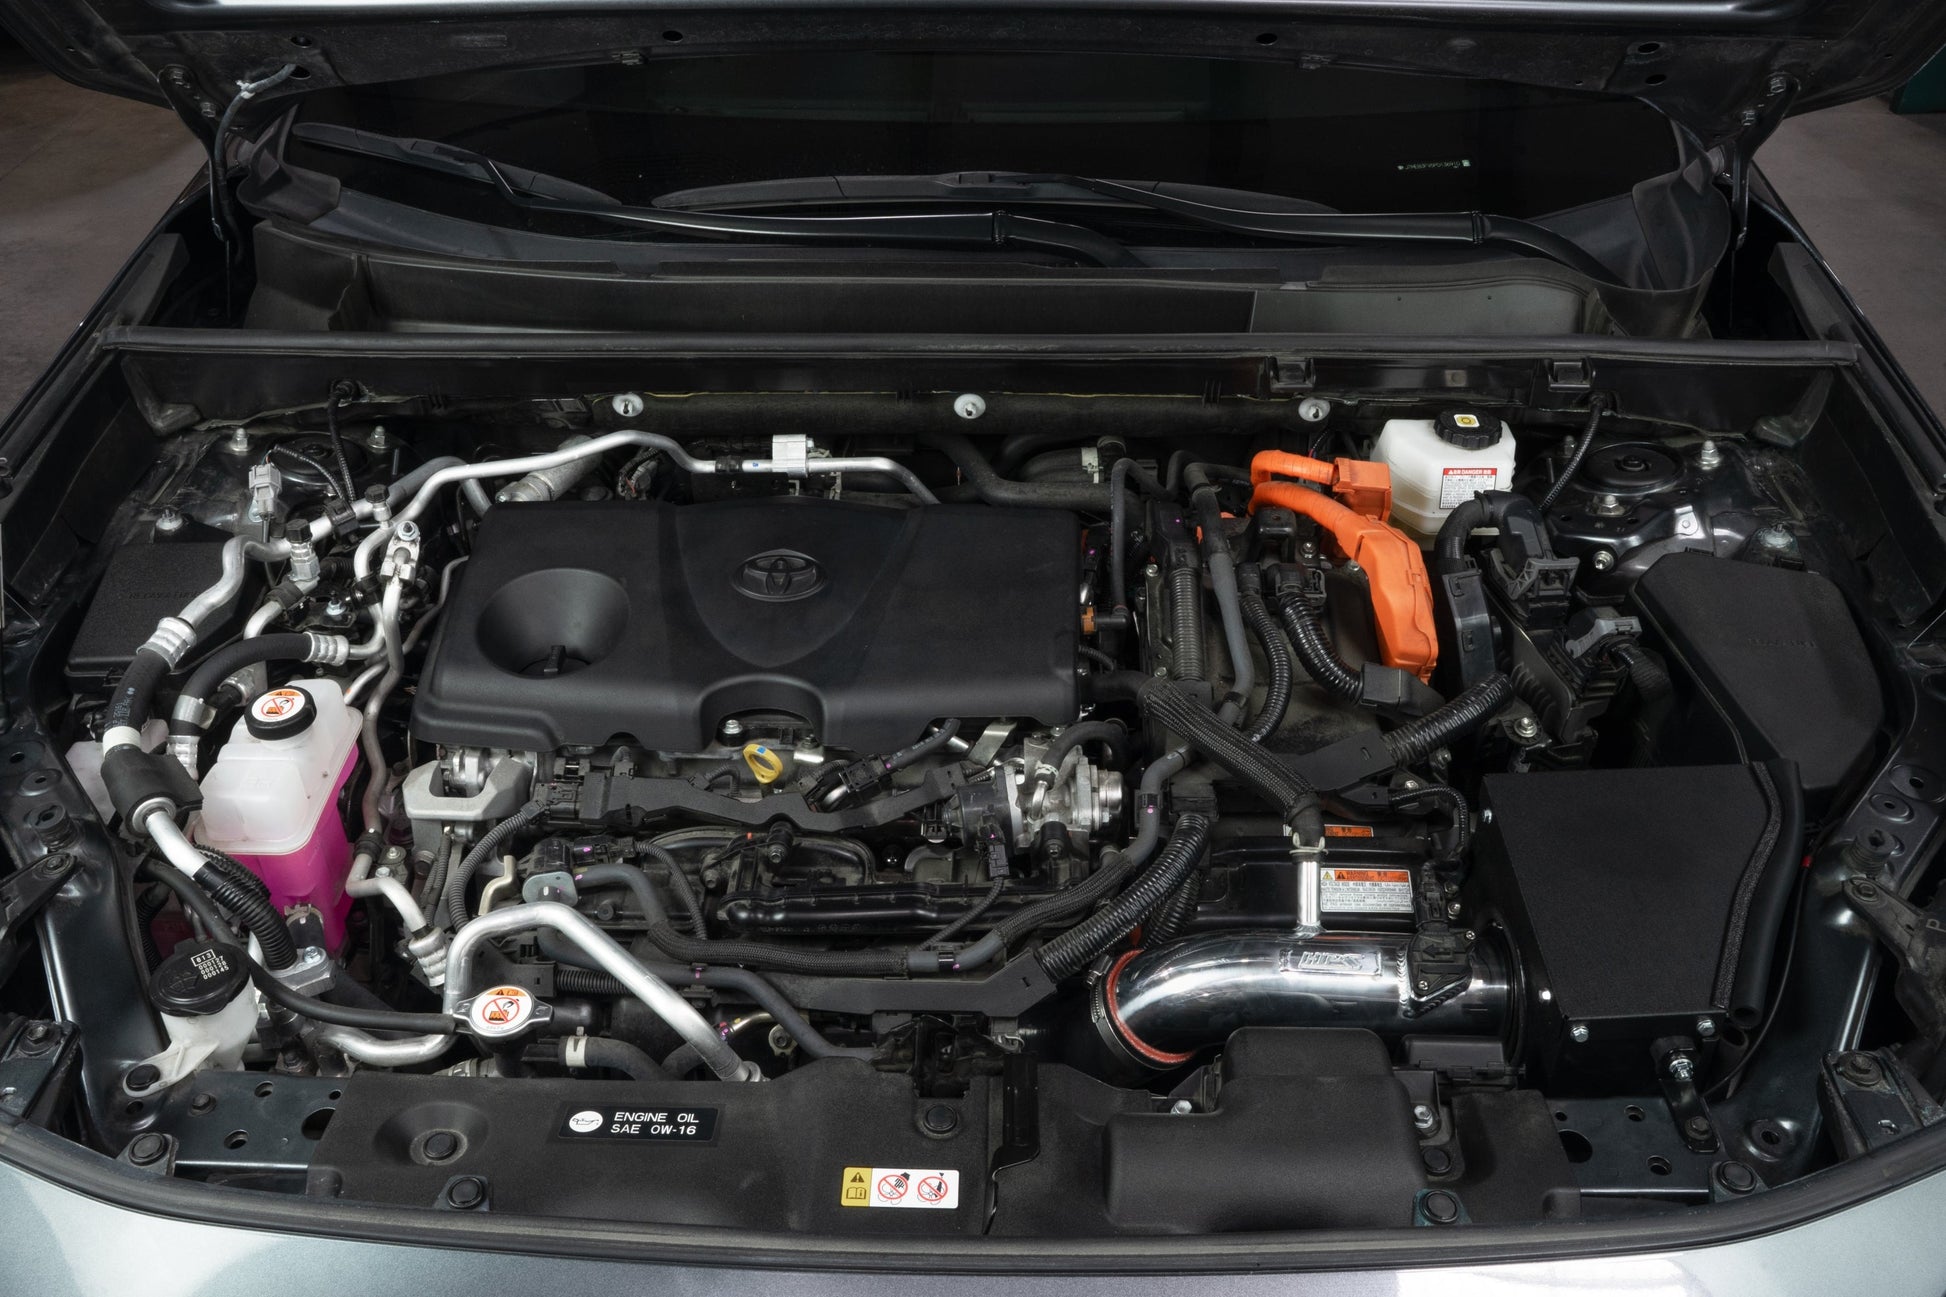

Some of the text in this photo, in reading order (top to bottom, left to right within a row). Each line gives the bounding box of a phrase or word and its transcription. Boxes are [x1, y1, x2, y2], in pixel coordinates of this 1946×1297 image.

[198, 955, 223, 970] 000127
[200, 960, 227, 974] 000128
[203, 965, 229, 979] 000145
[614, 1112, 700, 1123] ENGINE OIL
[610, 1124, 697, 1135] SAE 0W-16
